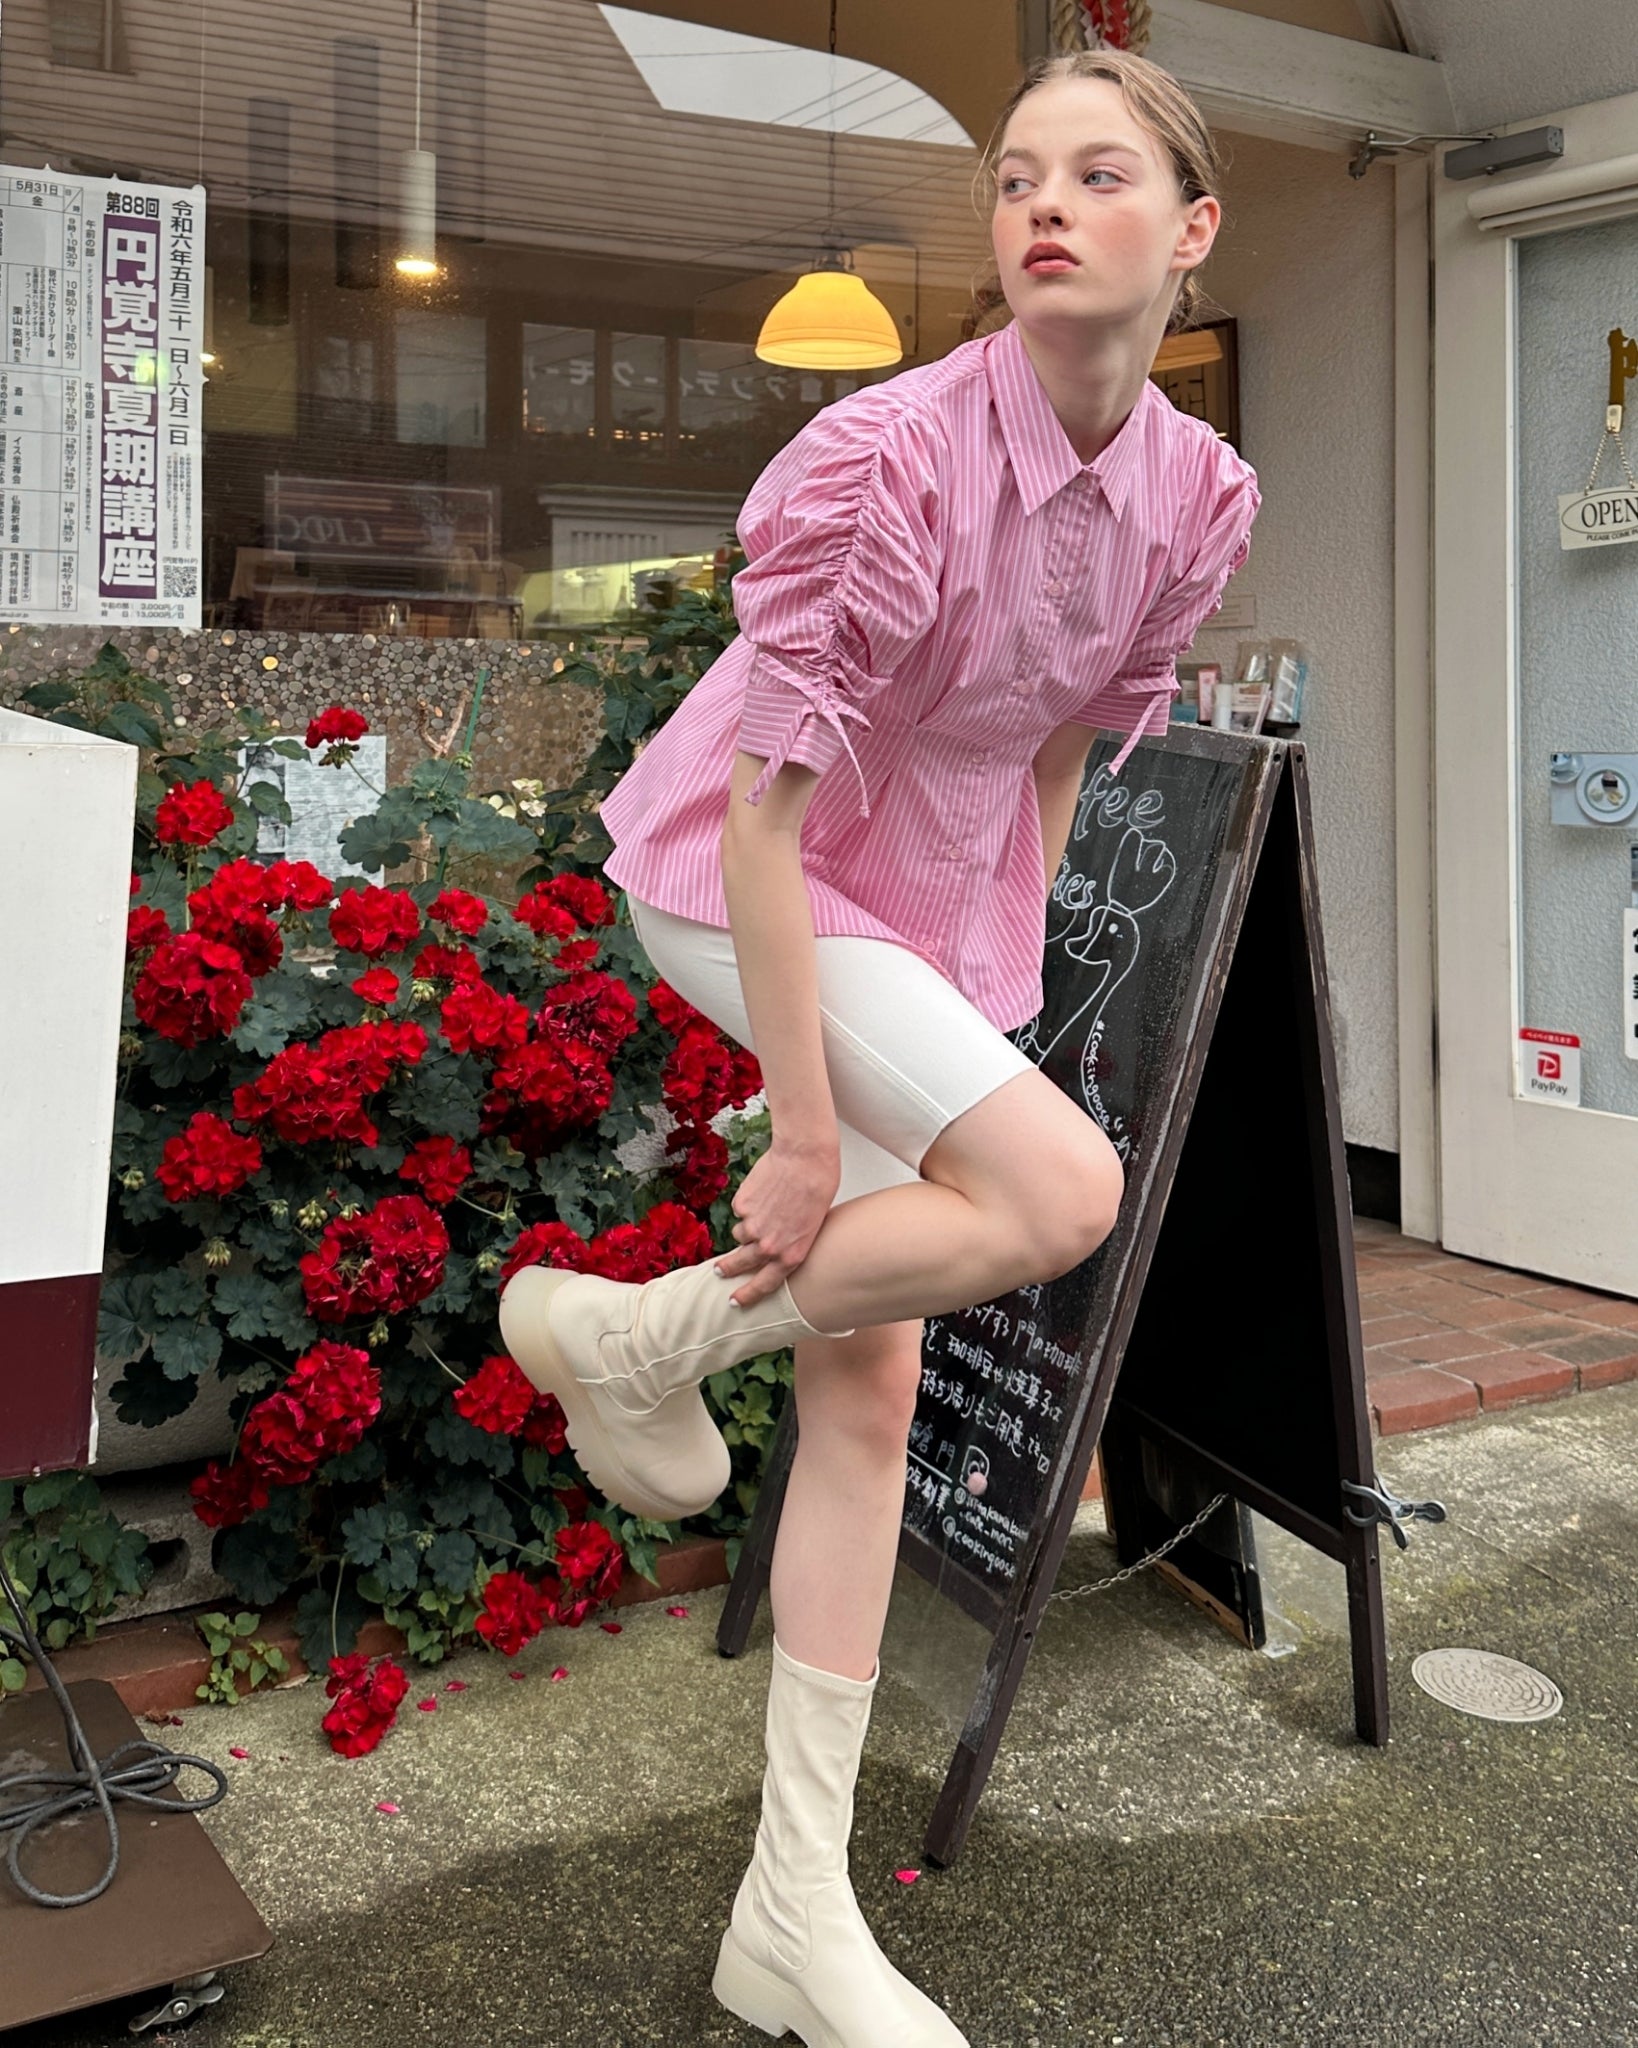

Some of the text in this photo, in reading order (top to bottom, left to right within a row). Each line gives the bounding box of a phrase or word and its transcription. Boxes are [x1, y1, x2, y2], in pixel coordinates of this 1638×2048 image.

[16, 181, 58, 196] 5月31日
[106, 191, 160, 219] 第88回
[101, 228, 158, 587] 円覚寺夏期講座
[1581, 497, 1638, 529] OPEN
[1611, 531, 1630, 540] COME
[1074, 762, 1166, 841] fee
[1052, 862, 1097, 910] ies
[1531, 1078, 1568, 1096] PayPay
